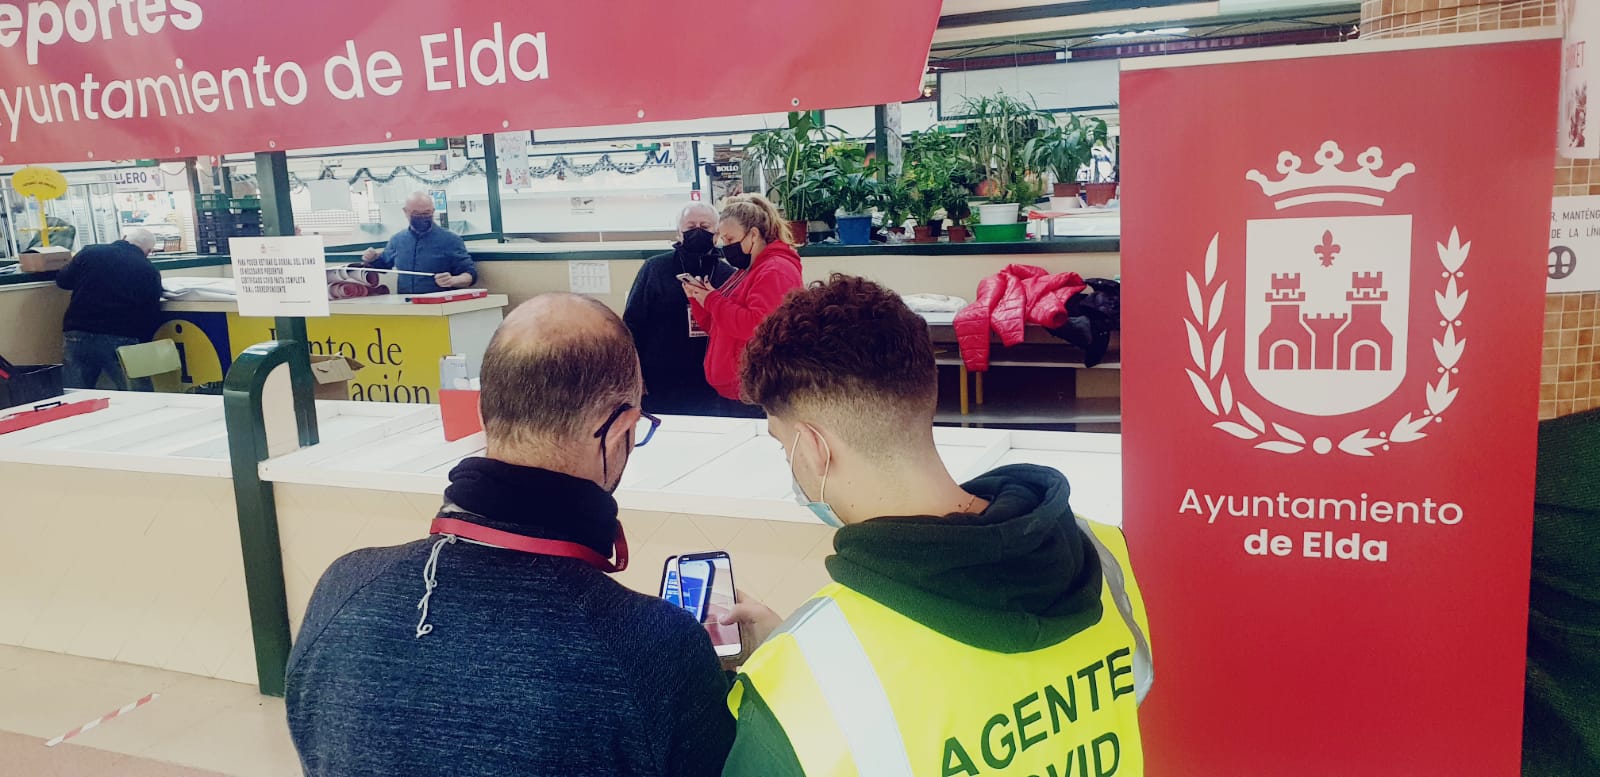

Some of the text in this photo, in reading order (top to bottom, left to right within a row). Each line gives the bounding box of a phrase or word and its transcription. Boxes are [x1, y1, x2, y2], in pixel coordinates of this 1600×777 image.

[0, 0, 203, 65] eportes
[0, 22, 549, 142] yuntamiento de Elda
[1568, 228, 1579, 238] LA
[367, 328, 403, 365] de
[1179, 489, 1463, 525] Ayuntamiento
[1244, 529, 1388, 562] de Elda
[942, 647, 1134, 777] AGENTE
